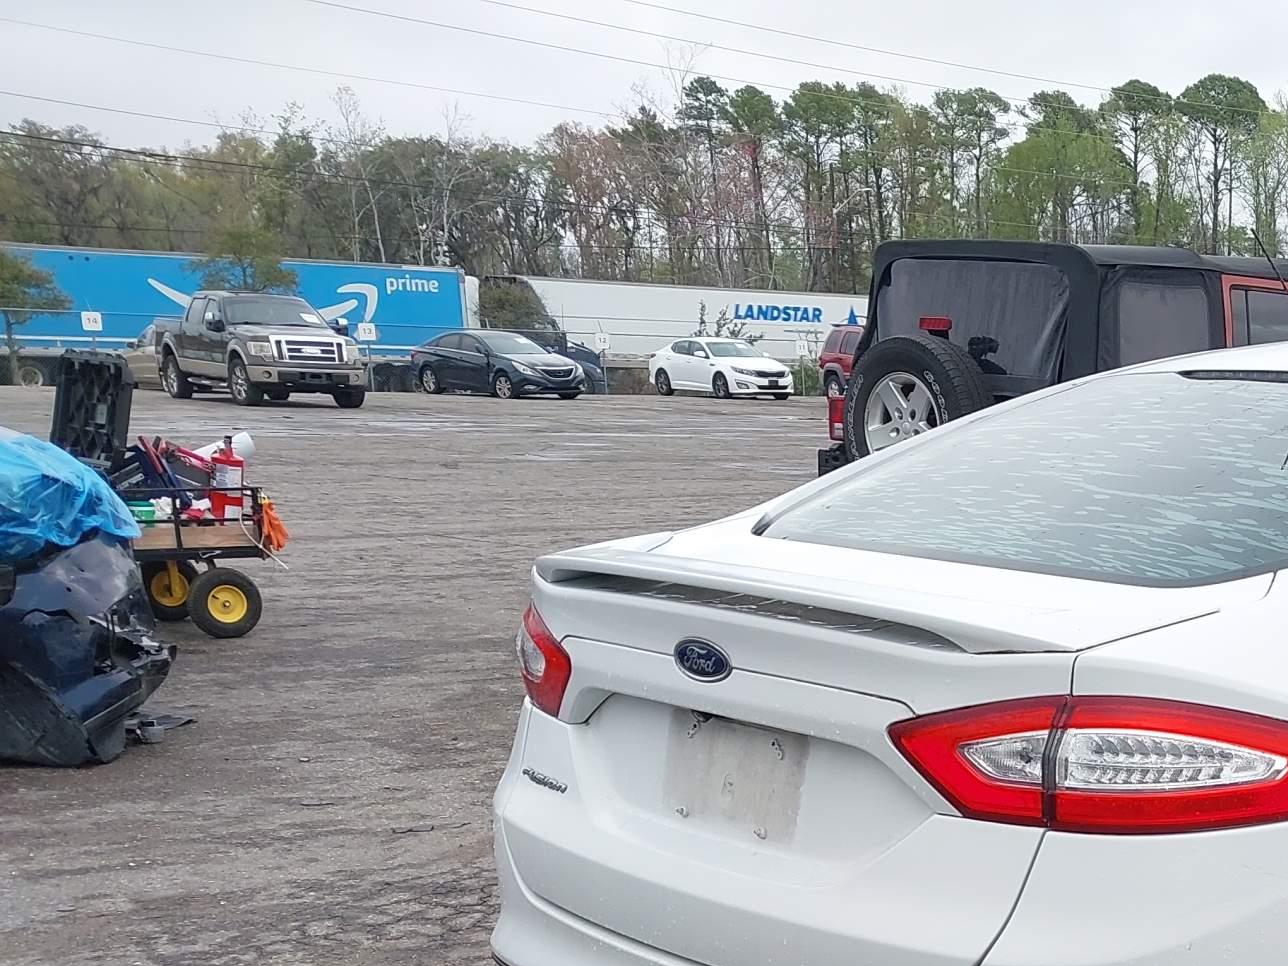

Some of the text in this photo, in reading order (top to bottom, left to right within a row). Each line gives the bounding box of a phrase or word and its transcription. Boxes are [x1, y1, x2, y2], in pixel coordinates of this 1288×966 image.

[385, 274, 439, 295] prime
[734, 303, 822, 323] LANDSTAR
[683, 646, 717, 673] Ford
